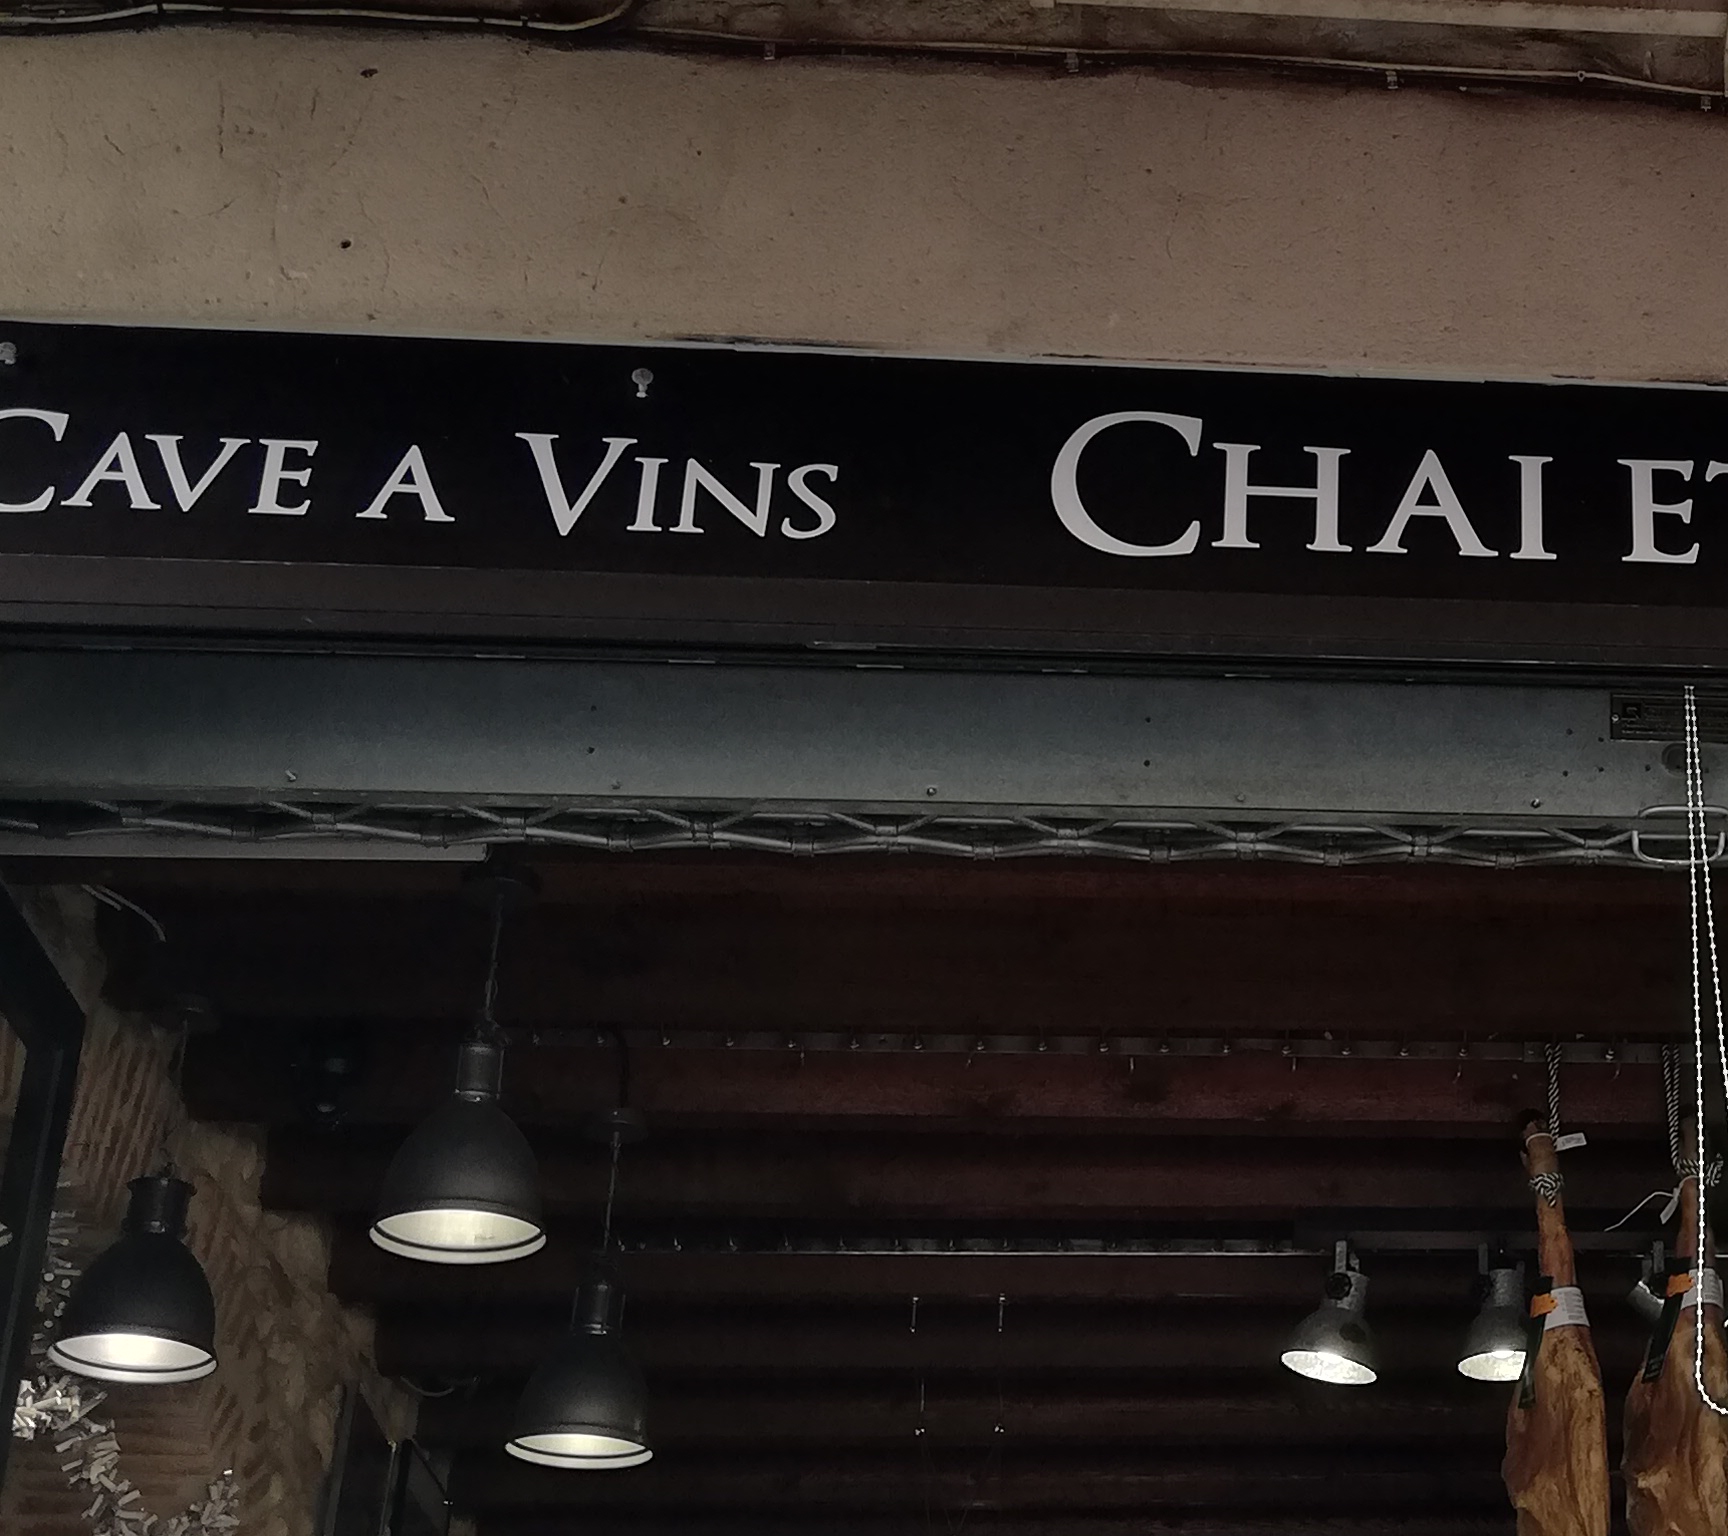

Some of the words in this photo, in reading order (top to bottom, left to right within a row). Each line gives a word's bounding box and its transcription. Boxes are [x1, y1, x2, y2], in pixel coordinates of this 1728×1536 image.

[355, 444, 455, 522] A
[515, 432, 839, 540] VINS
[1051, 411, 1557, 560] CHAI
